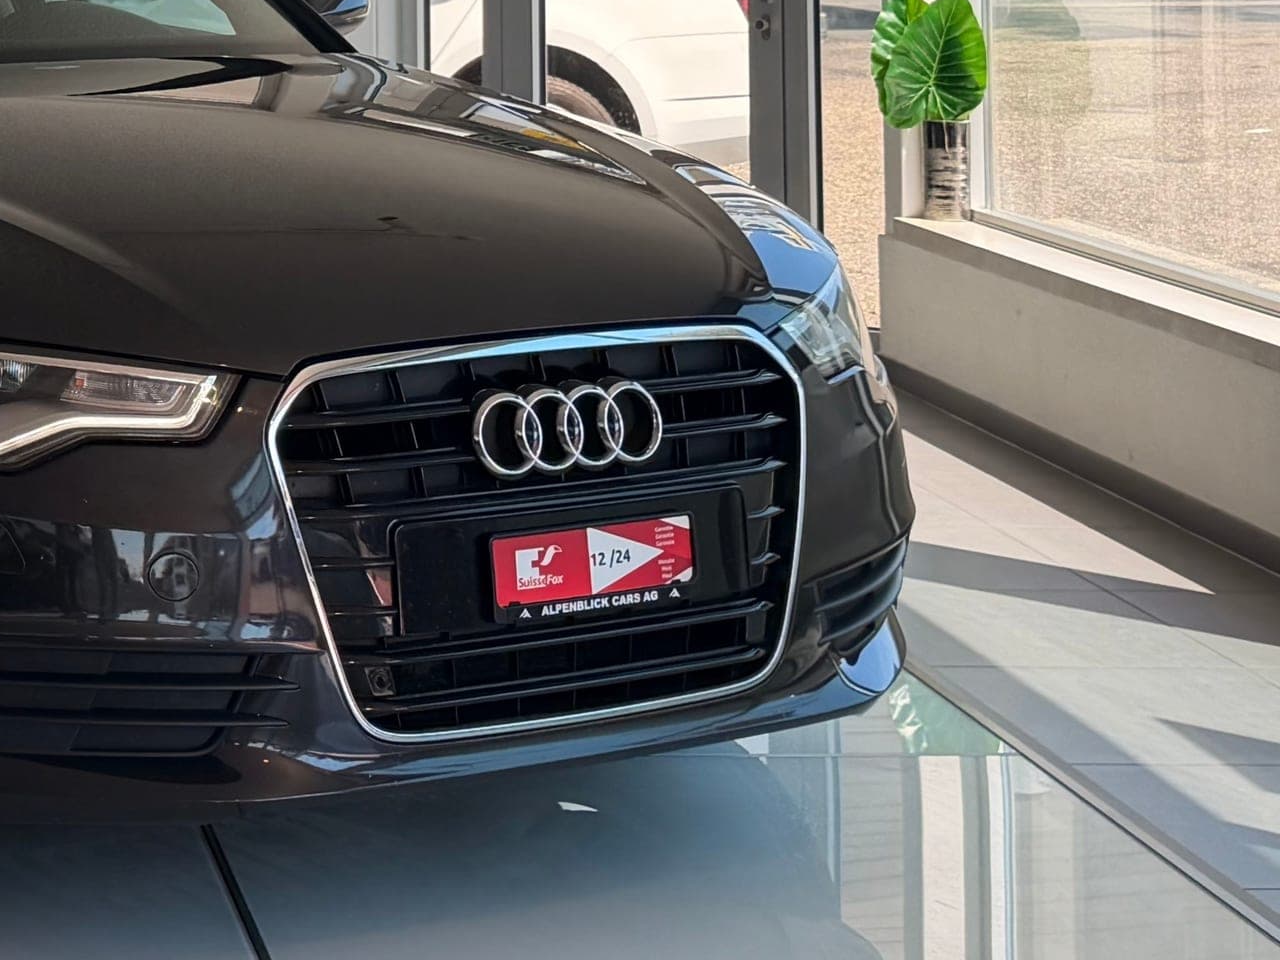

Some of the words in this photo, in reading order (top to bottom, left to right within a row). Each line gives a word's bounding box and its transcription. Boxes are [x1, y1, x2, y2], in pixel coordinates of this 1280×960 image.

[541, 597, 609, 617] ALPENBLICK
[611, 593, 641, 607] CARS
[642, 590, 659, 603] AG
